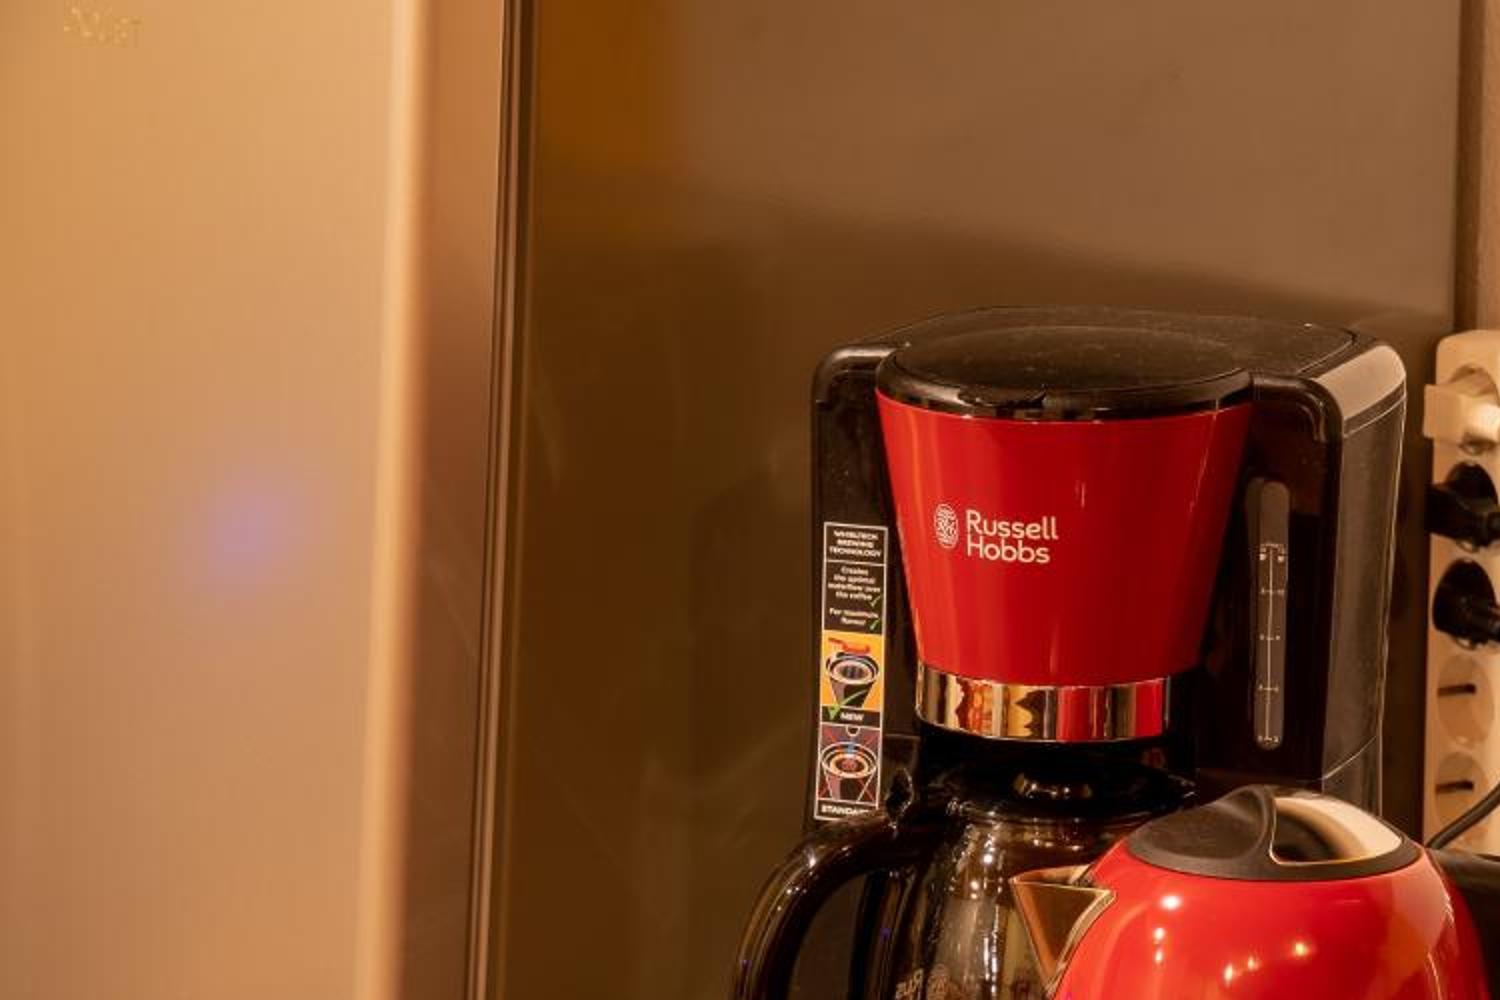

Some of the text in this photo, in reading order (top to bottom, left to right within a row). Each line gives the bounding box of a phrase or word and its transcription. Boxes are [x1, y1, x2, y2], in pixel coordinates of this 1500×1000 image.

[966, 509, 1059, 540] Russell
[967, 533, 1051, 563] Hobbs
[840, 711, 864, 722] NEW
